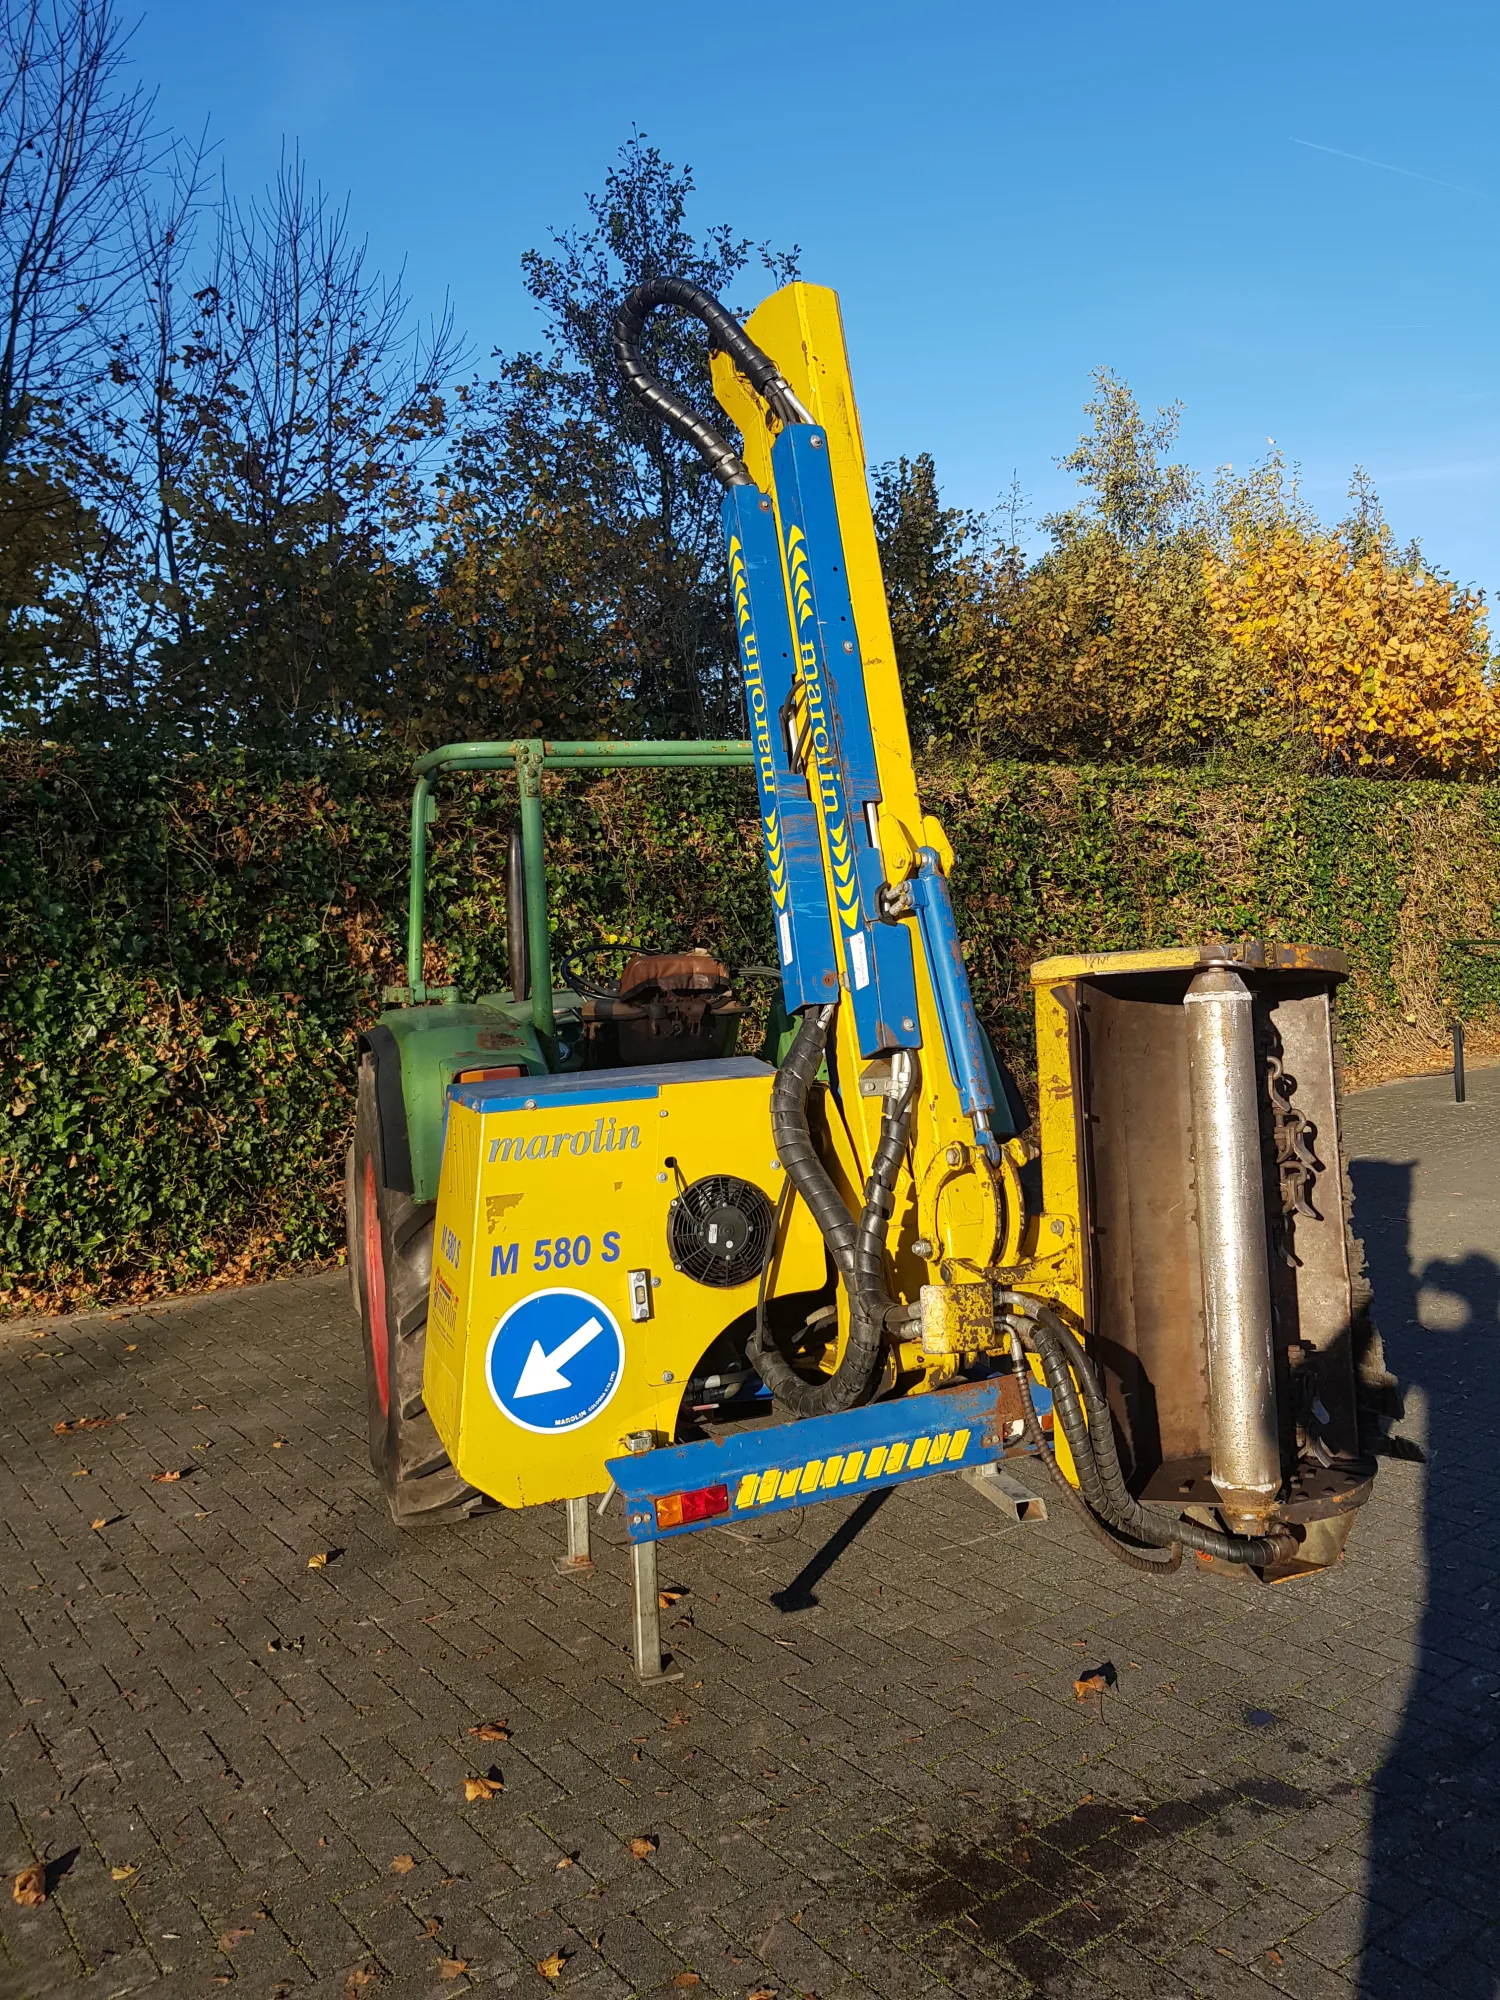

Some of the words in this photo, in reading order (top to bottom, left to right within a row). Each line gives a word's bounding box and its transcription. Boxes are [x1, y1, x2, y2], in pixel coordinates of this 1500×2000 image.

[743, 632, 776, 794] marolin
[800, 640, 841, 814] marolin
[488, 1117, 641, 1162] marolin
[490, 1242, 520, 1277] M
[533, 1234, 592, 1271] 580
[601, 1230, 621, 1262] S
[554, 1409, 587, 1426] MAROLIN
